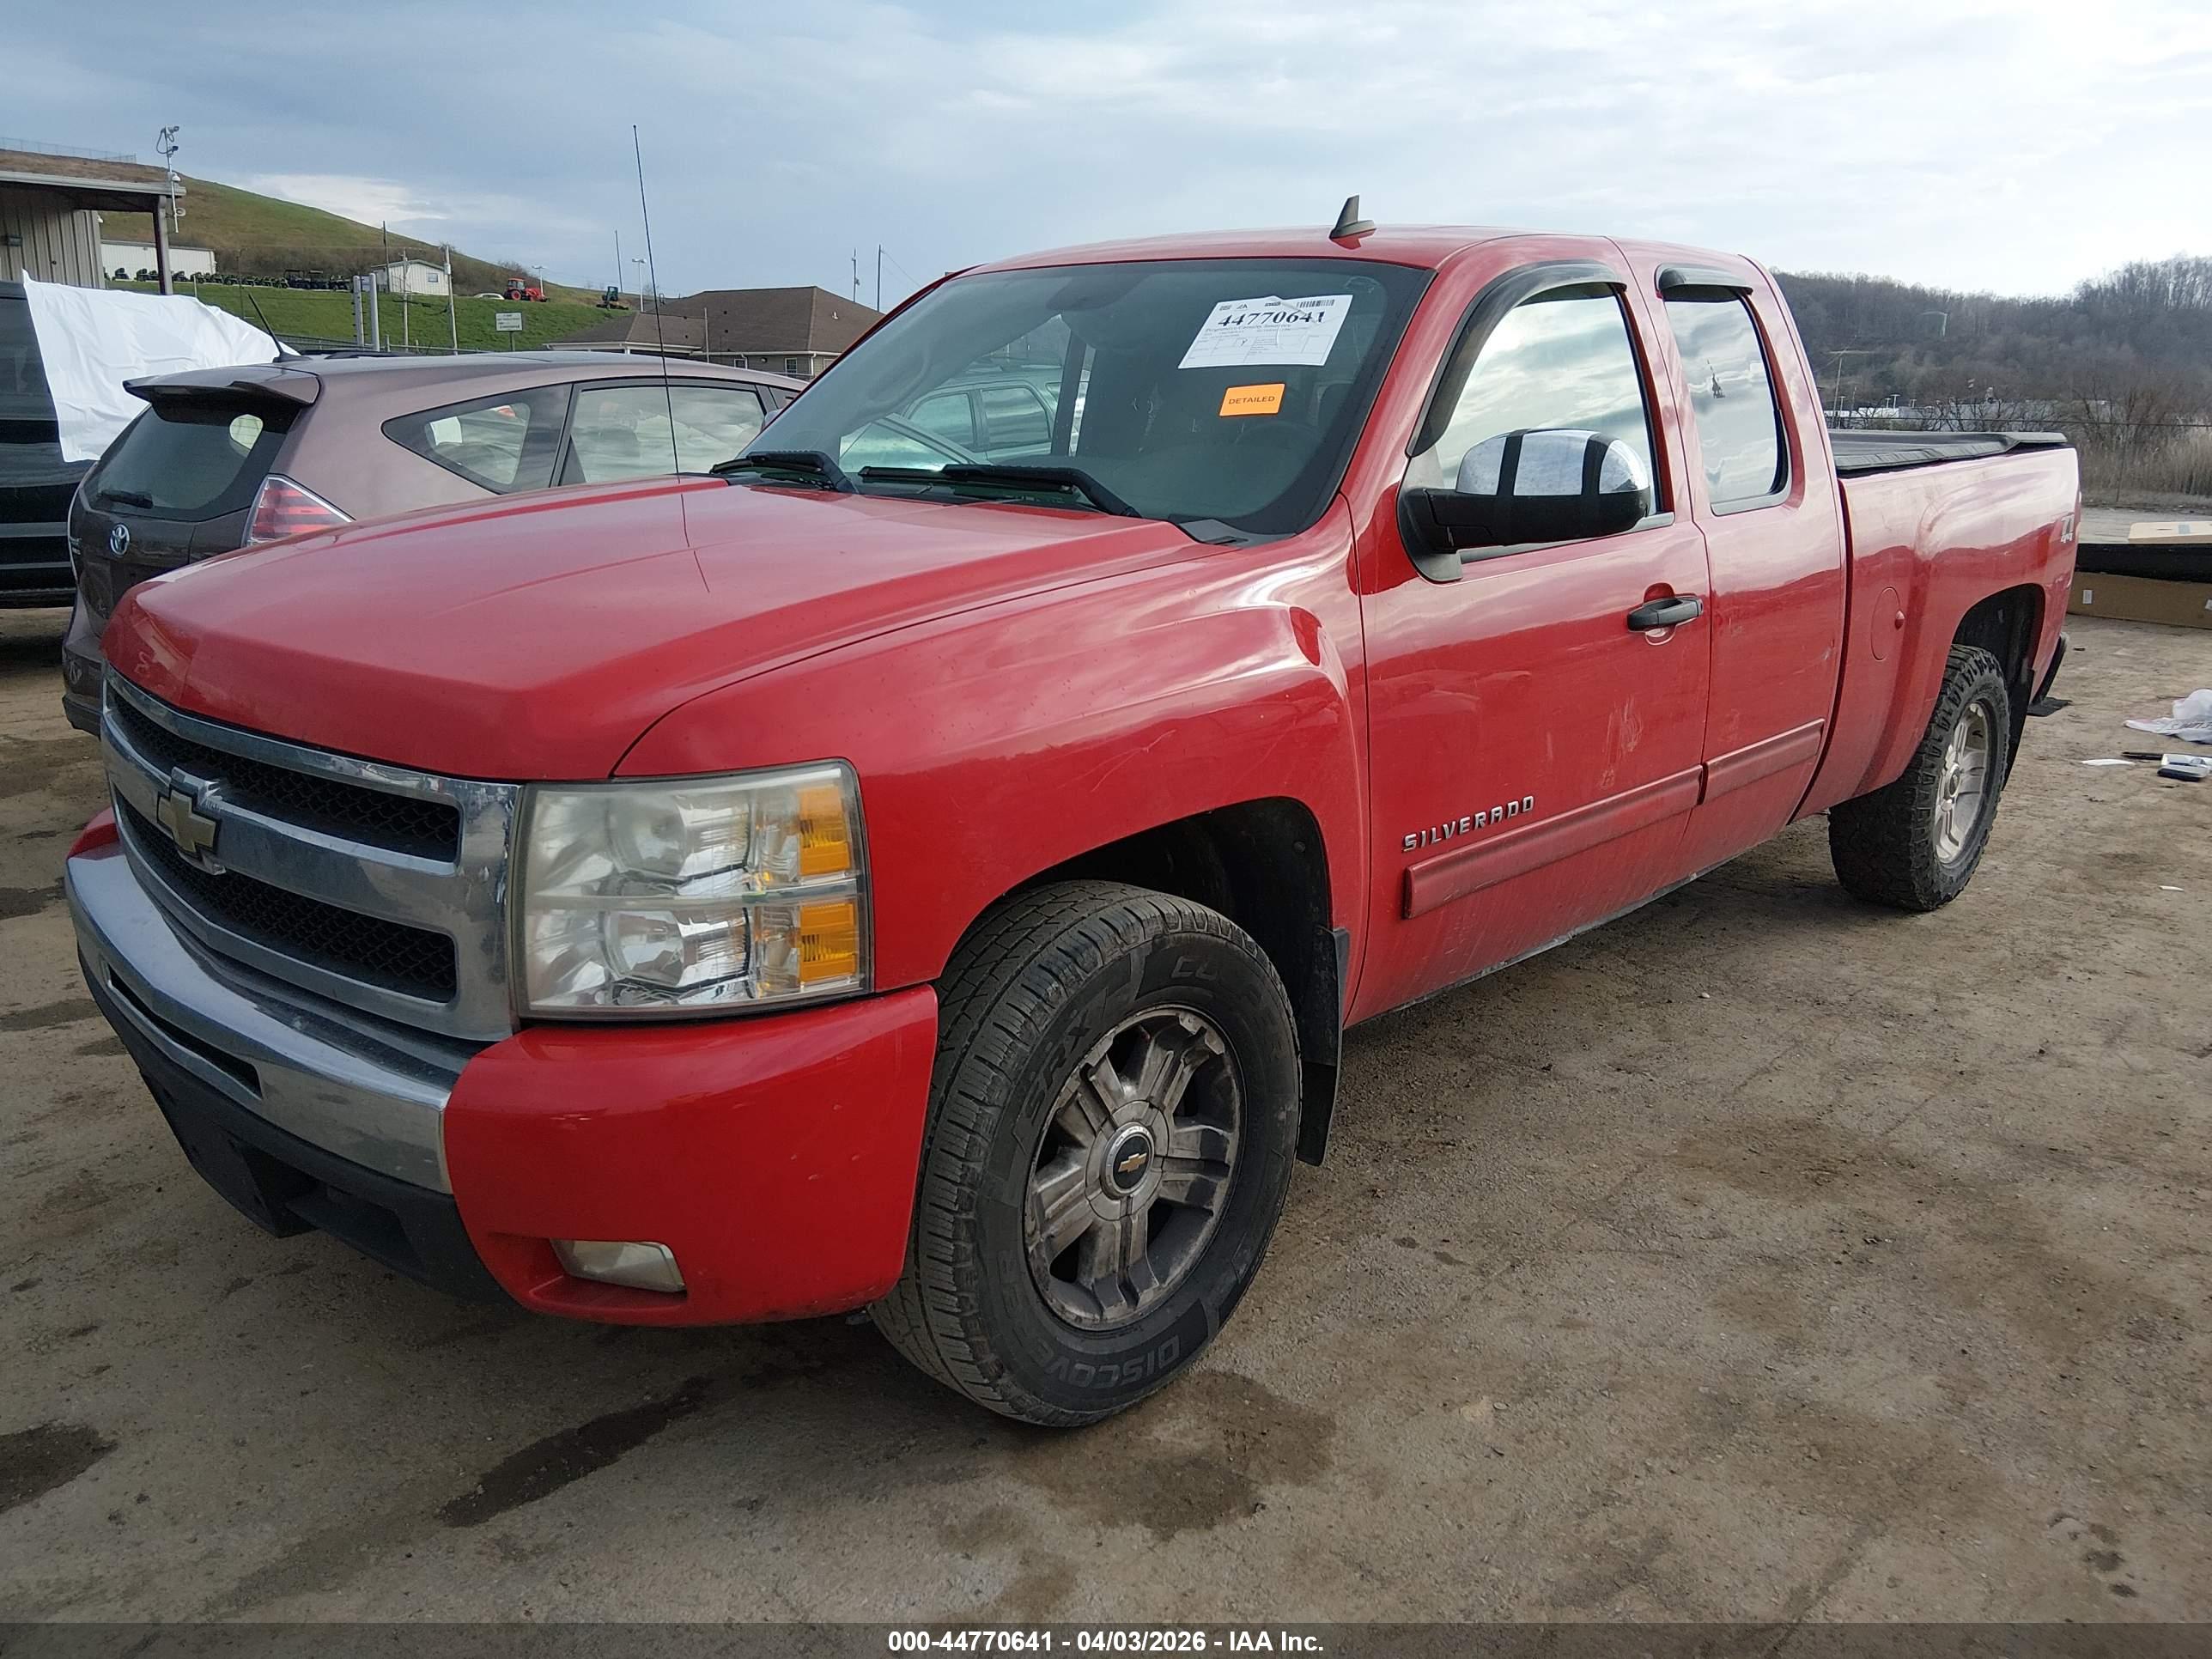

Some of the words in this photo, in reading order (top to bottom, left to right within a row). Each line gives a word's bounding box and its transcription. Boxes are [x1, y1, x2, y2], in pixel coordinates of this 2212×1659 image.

[1218, 310, 1325, 326] 44770641
[1229, 396, 1275, 404] DETAILED
[1403, 795, 1534, 852] SILVERADO
